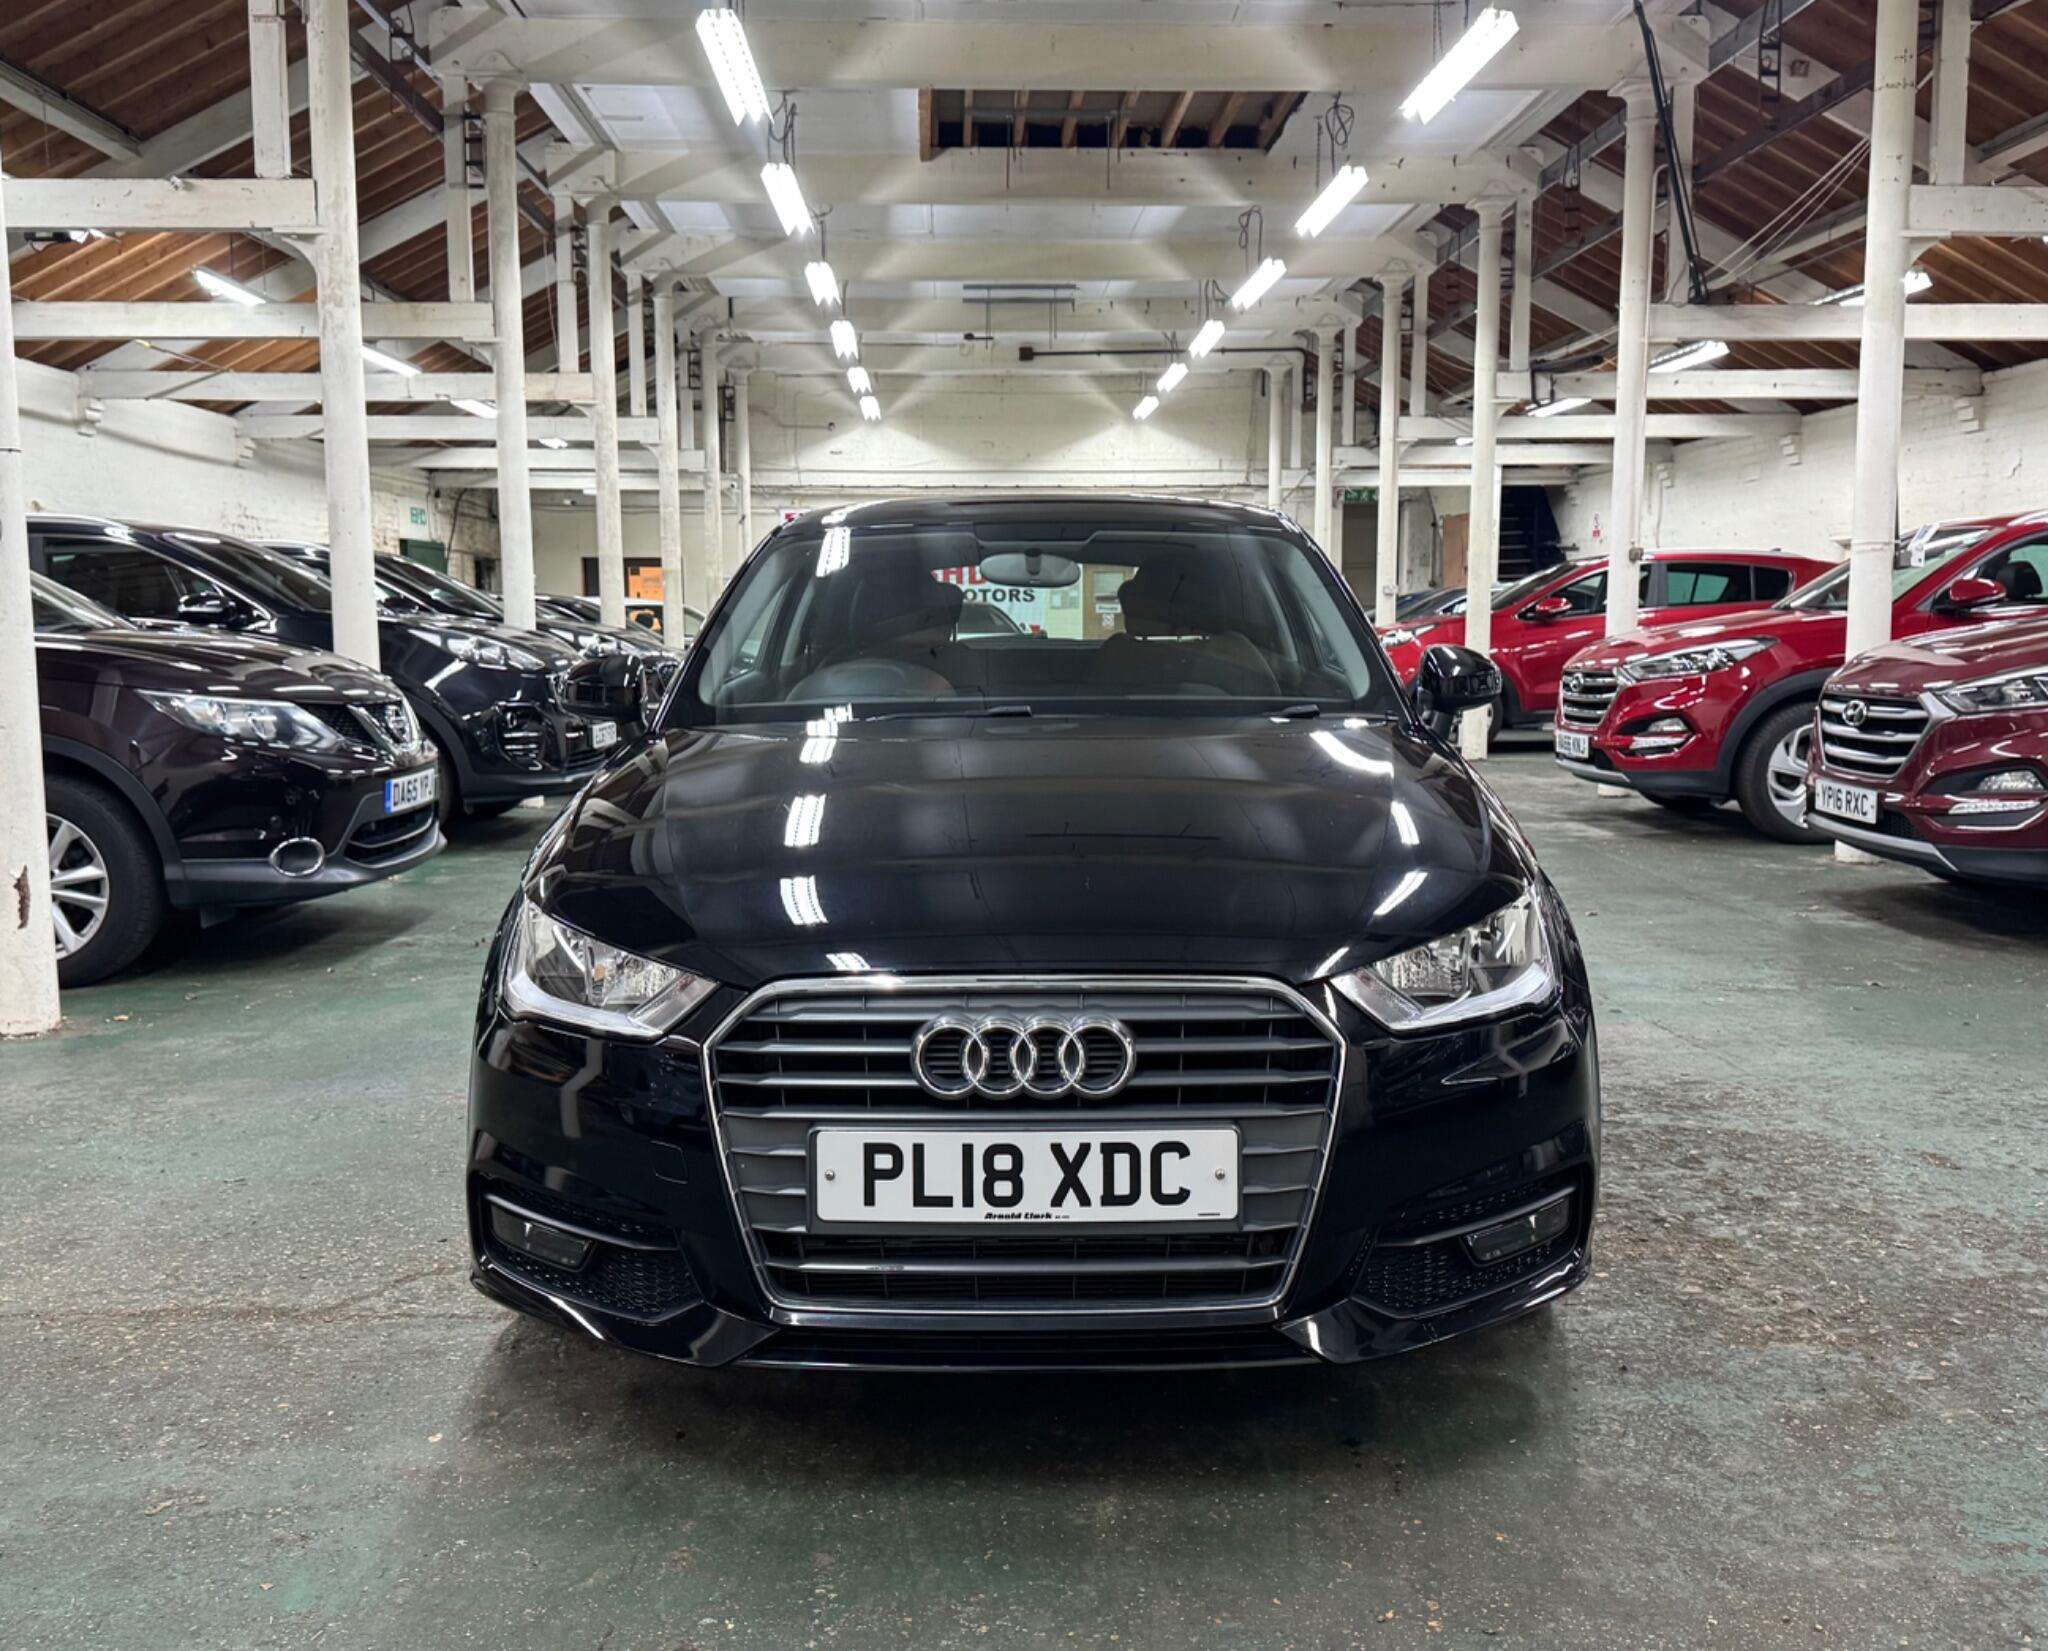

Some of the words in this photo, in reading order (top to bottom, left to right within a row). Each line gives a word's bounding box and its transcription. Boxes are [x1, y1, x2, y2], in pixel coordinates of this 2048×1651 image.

[963, 588, 1036, 602] OTORS
[1822, 784, 1843, 810] YP16
[1845, 790, 1869, 816] RXC
[863, 1142, 1024, 1208] PL18
[1050, 1141, 1191, 1207] XDC
